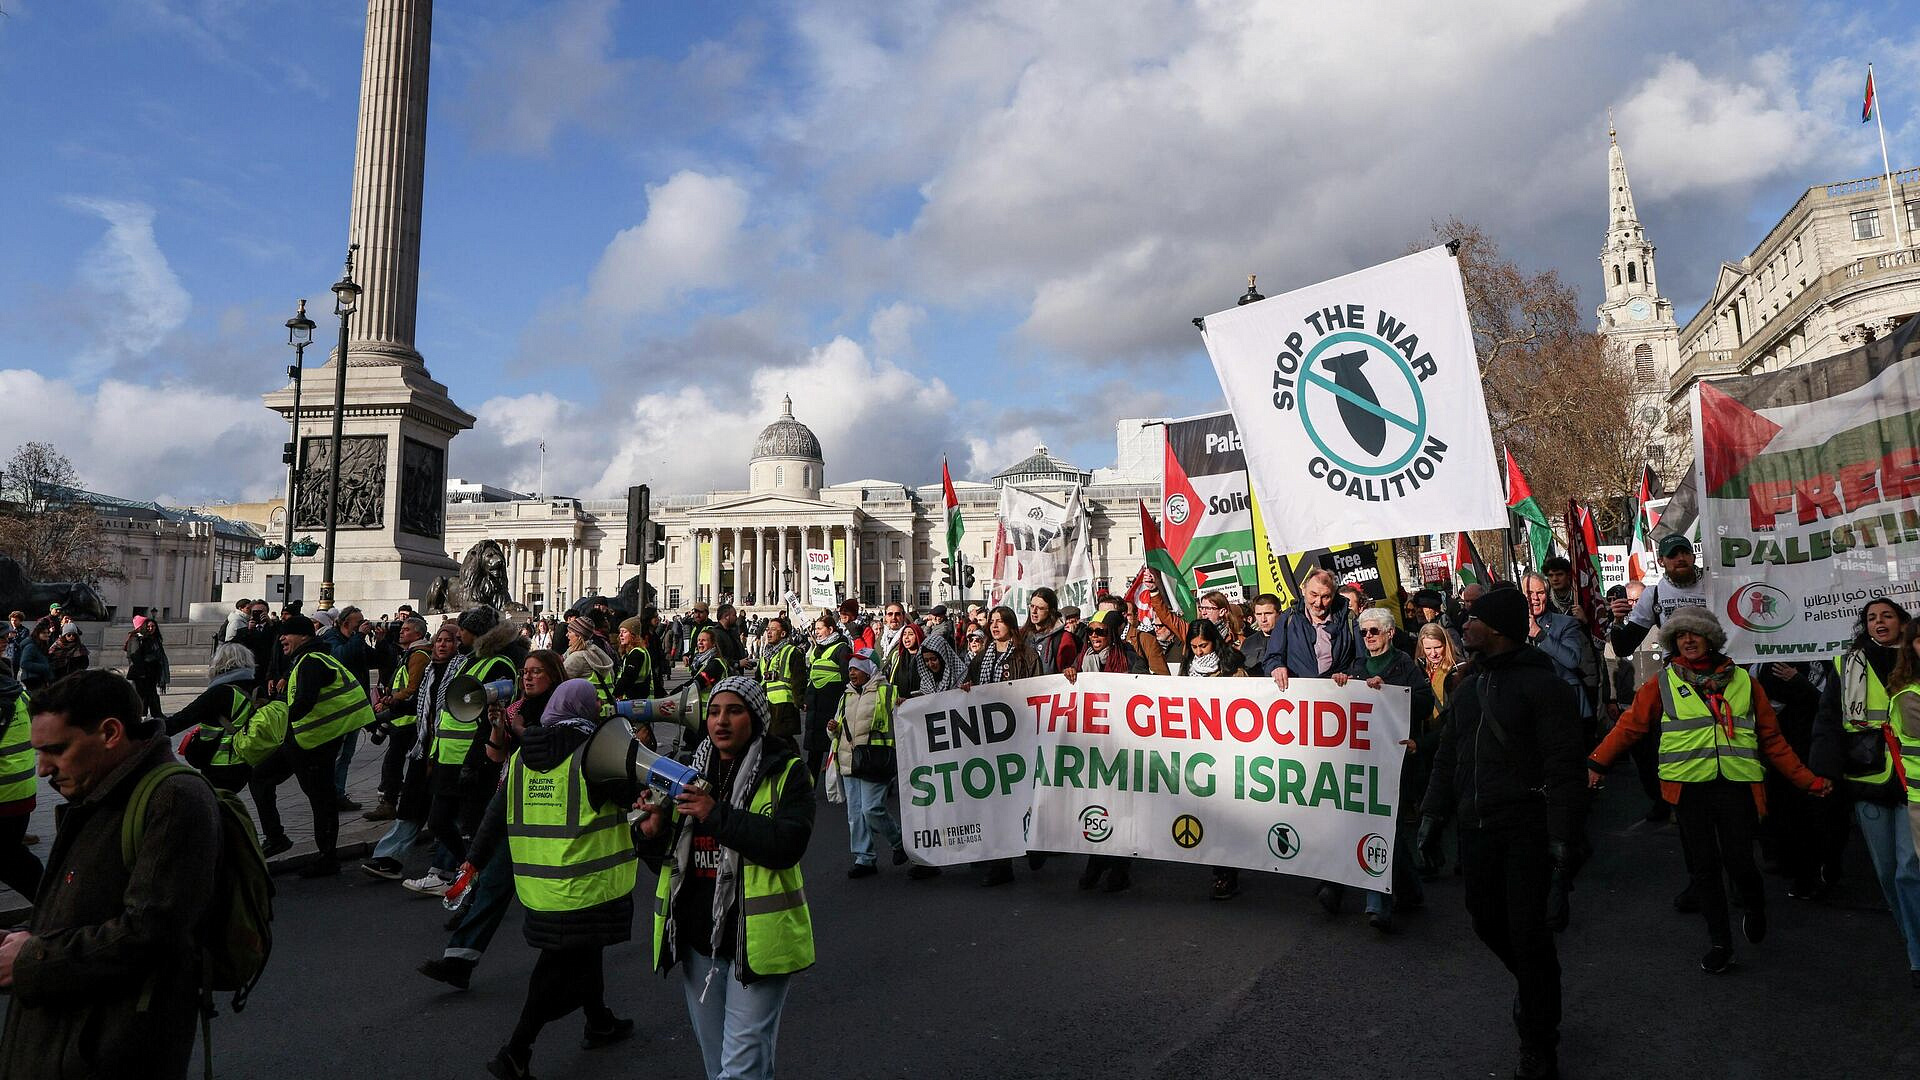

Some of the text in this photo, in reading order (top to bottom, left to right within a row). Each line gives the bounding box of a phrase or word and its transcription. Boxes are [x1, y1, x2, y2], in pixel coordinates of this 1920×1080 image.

[1273, 304, 1438, 411] STOP THE WAR
[1308, 435, 1449, 502] COALITION
[809, 553, 829, 563] STOP
[1333, 553, 1361, 570] Free
[1334, 566, 1379, 587] alestine
[1600, 564, 1625, 572] rming
[1601, 573, 1624, 582] srael
[812, 588, 833, 596] ISRAEL
[925, 692, 1374, 753] END THE GENOCIDE
[910, 745, 1392, 817] STOP ARMING ISRAEL
[947, 823, 981, 838] FRIENDS
[1084, 818, 1107, 831] PSC
[914, 829, 942, 849] FOA
[957, 834, 982, 845] AL-AQSA
[1367, 847, 1387, 864] PFB
